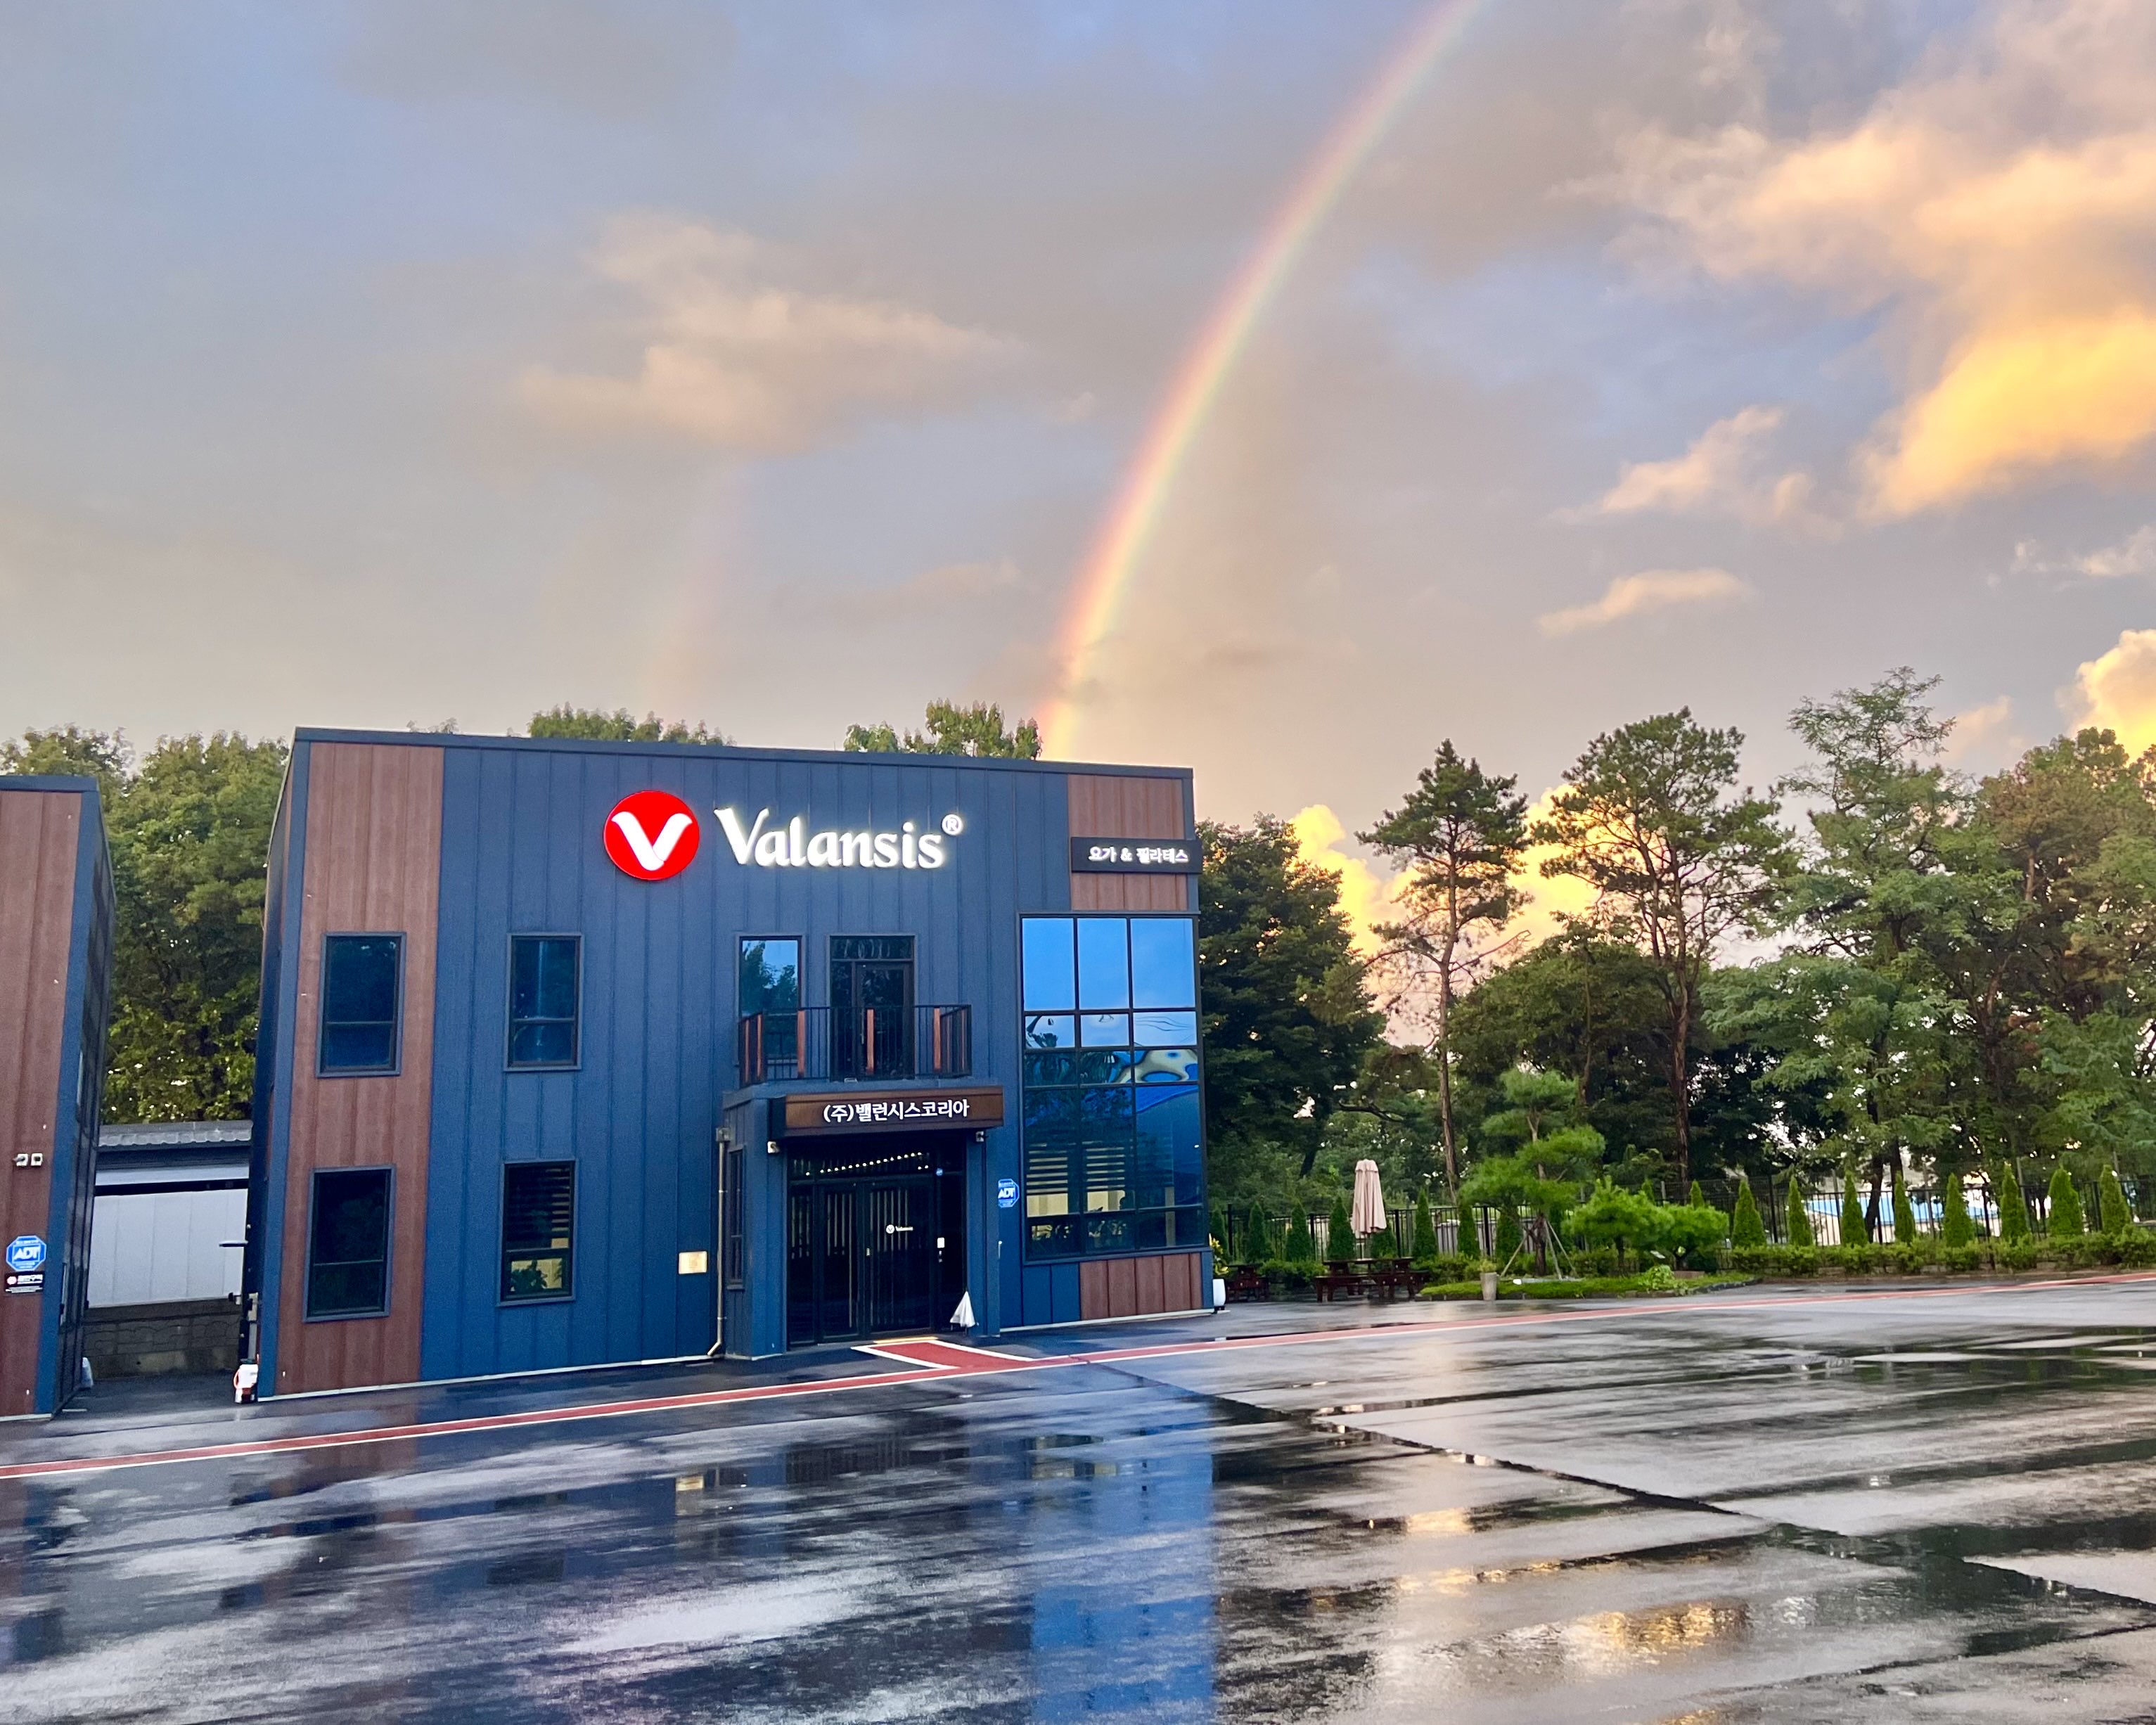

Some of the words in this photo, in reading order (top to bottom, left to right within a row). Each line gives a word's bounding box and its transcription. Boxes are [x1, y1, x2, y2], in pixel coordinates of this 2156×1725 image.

[1088, 846, 1117, 864] 요가
[1120, 847, 1133, 863] &
[1136, 847, 1189, 865] 필라테스
[823, 1098, 970, 1123] (주)밸런시스코리아
[998, 1187, 1015, 1199] ADT
[13, 1246, 40, 1260] ADT
